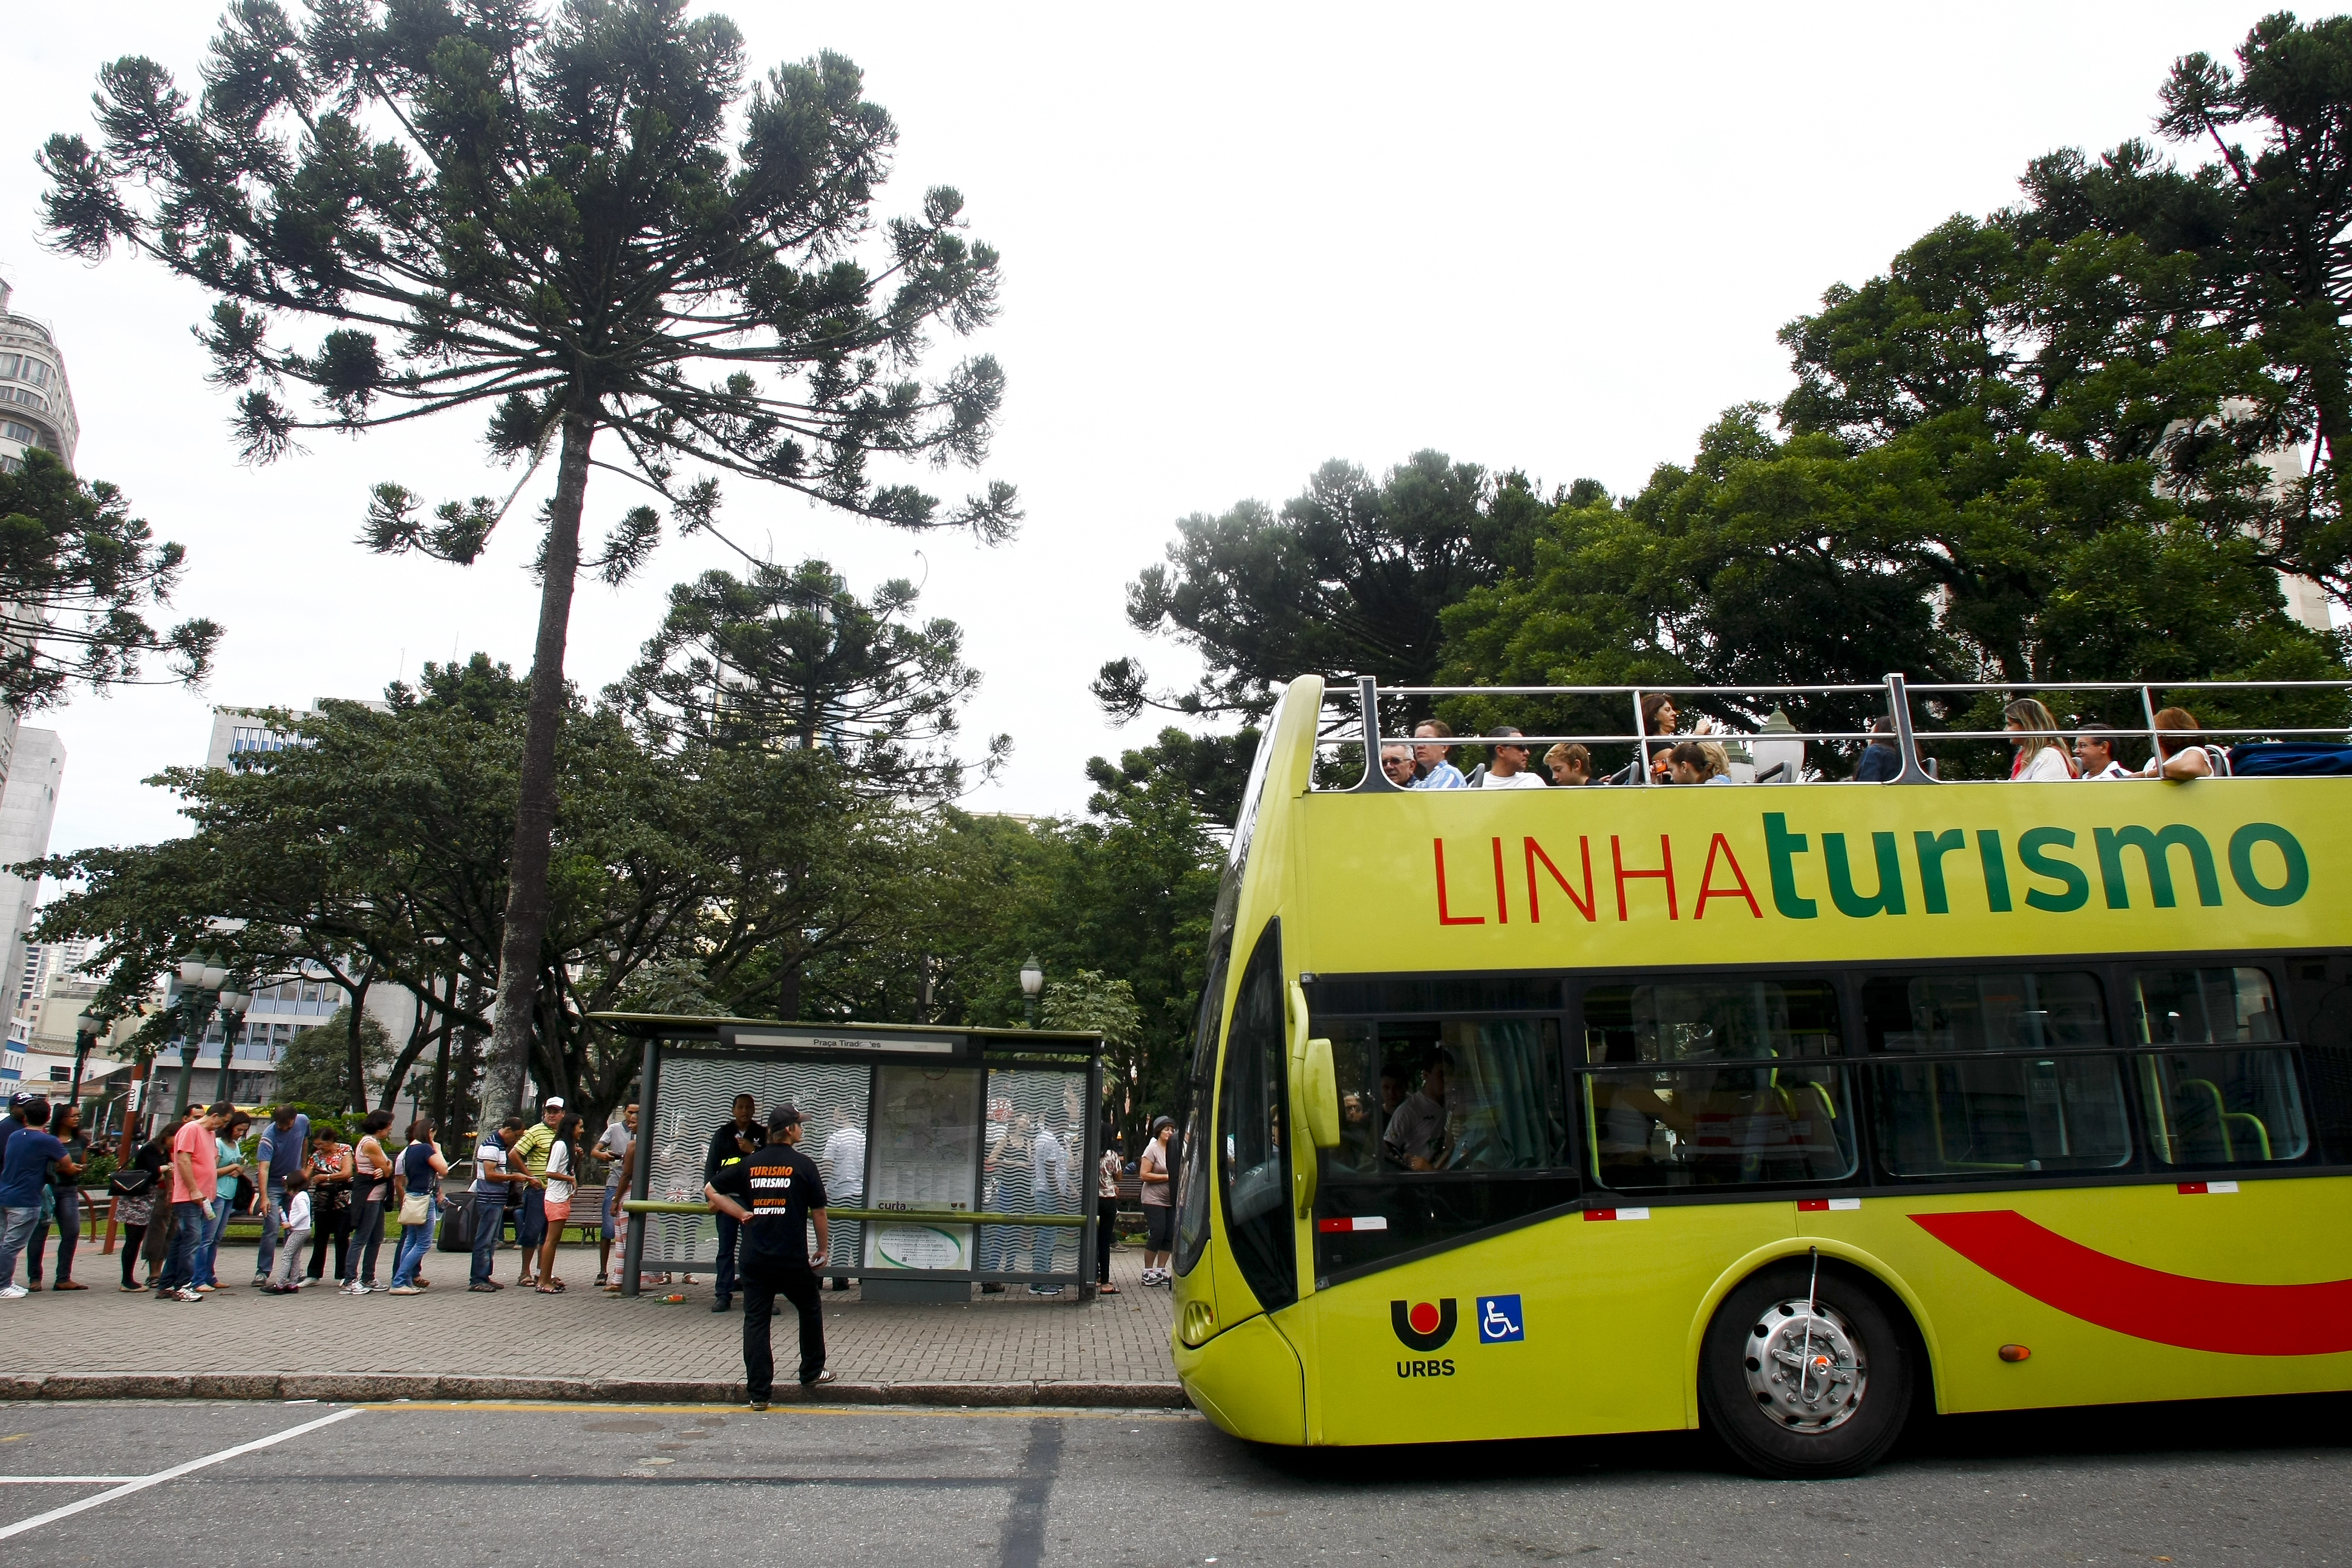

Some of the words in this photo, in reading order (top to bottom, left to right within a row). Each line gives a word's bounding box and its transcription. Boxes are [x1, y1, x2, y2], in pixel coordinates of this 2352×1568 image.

[750, 1166, 794, 1177] TURISMO
[750, 1178, 791, 1189] TURISMO
[878, 1201, 906, 1210] curta
[1396, 1359, 1455, 1378] URBS
